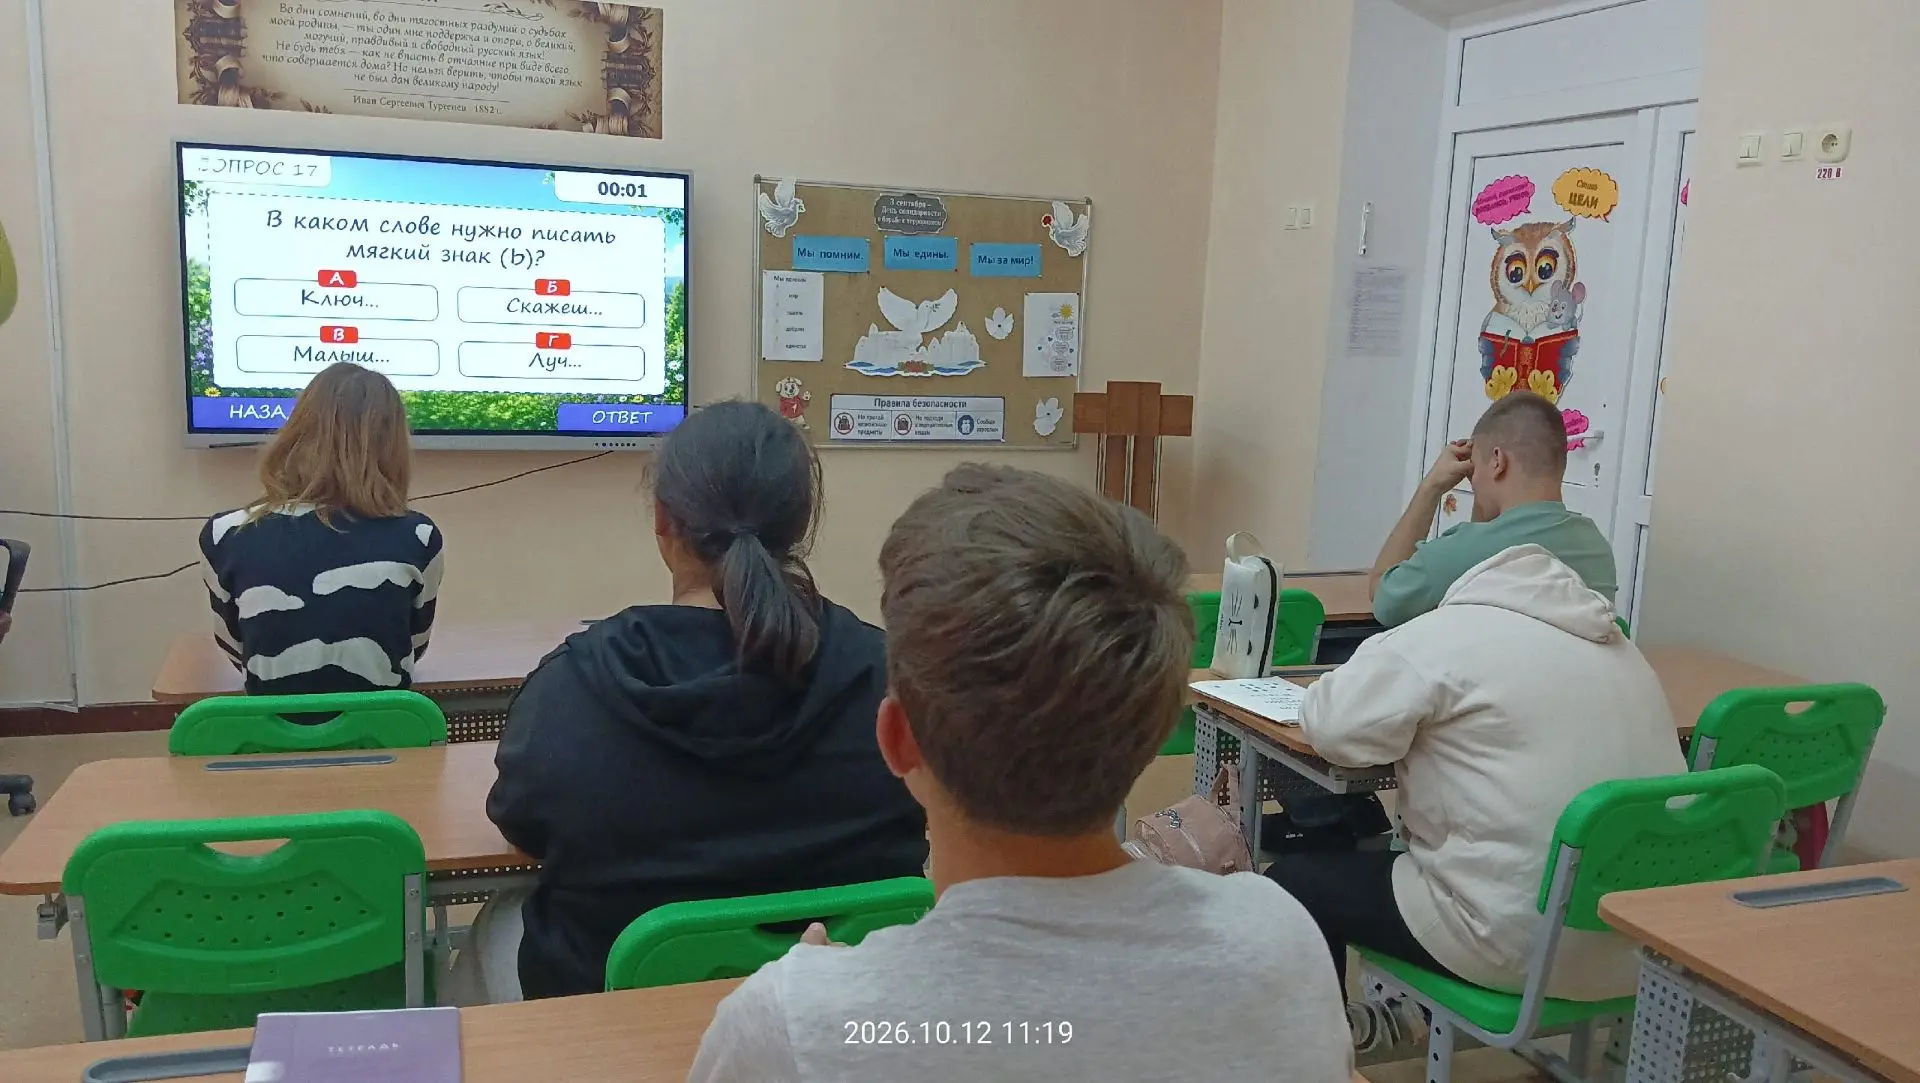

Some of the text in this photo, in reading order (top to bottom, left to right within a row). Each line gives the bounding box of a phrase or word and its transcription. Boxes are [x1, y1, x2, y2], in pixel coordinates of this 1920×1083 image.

[279, 3, 293, 14] Во
[296, 4, 315, 16] дни
[318, 8, 371, 21] сомнений,
[373, 10, 386, 22] во
[388, 11, 406, 23] дни
[409, 16, 468, 28] тягостных
[471, 22, 518, 34] раздумий
[528, 26, 567, 38] судьбах
[269, 16, 295, 26] моей
[376, 24, 401, 35] один
[404, 29, 424, 37] мне
[426, 29, 480, 42] поддержка
[492, 37, 524, 48] опора,
[534, 38, 576, 52] великий,
[304, 32, 348, 44] могучий,
[351, 34, 408, 48] правдивый
[420, 40, 474, 54] свободный
[478, 47, 516, 57] русский
[518, 51, 545, 60] язык!
[276, 40, 291, 50] Не
[294, 42, 317, 54] будь
[319, 44, 346, 55] тебя
[362, 50, 381, 58] как
[398, 49, 436, 62] впасть
[438, 53, 445, 62] в
[447, 57, 496, 68] отчаяние
[500, 61, 517, 71] при
[520, 60, 542, 72] виде
[544, 64, 569, 74] всего
[262, 54, 583, 88] что совершается дома? Но нельзя верить, чтобы такой язык
[354, 72, 499, 94] не был дан великому народу!
[353, 96, 377, 105] Иван
[380, 97, 425, 108] Сергеевич
[428, 101, 467, 112] Тургенев
[199, 157, 318, 177] ОПРОС 17
[1817, 168, 1832, 179] 220
[598, 182, 647, 198] 00:01
[1568, 192, 1600, 210] ЦЕЛИ
[266, 210, 616, 244] В каком слове нужно писать
[346, 244, 430, 261] мягкий
[440, 248, 492, 264] знак
[797, 247, 864, 260] Мы помним.
[893, 248, 949, 260] Мы едины.
[978, 255, 1034, 268] Мы за мир!
[330, 272, 344, 286] А
[546, 280, 558, 294] Б
[302, 288, 379, 308] Ключ...
[506, 297, 602, 316] Скажеш...
[333, 328, 345, 342] В
[548, 334, 560, 348] Г
[294, 346, 390, 363] Малыш...
[528, 352, 582, 372] Луч...
[229, 404, 289, 420] НАЗА
[874, 398, 967, 409] Правила безопасности
[592, 410, 654, 425] ОТВЕТ
